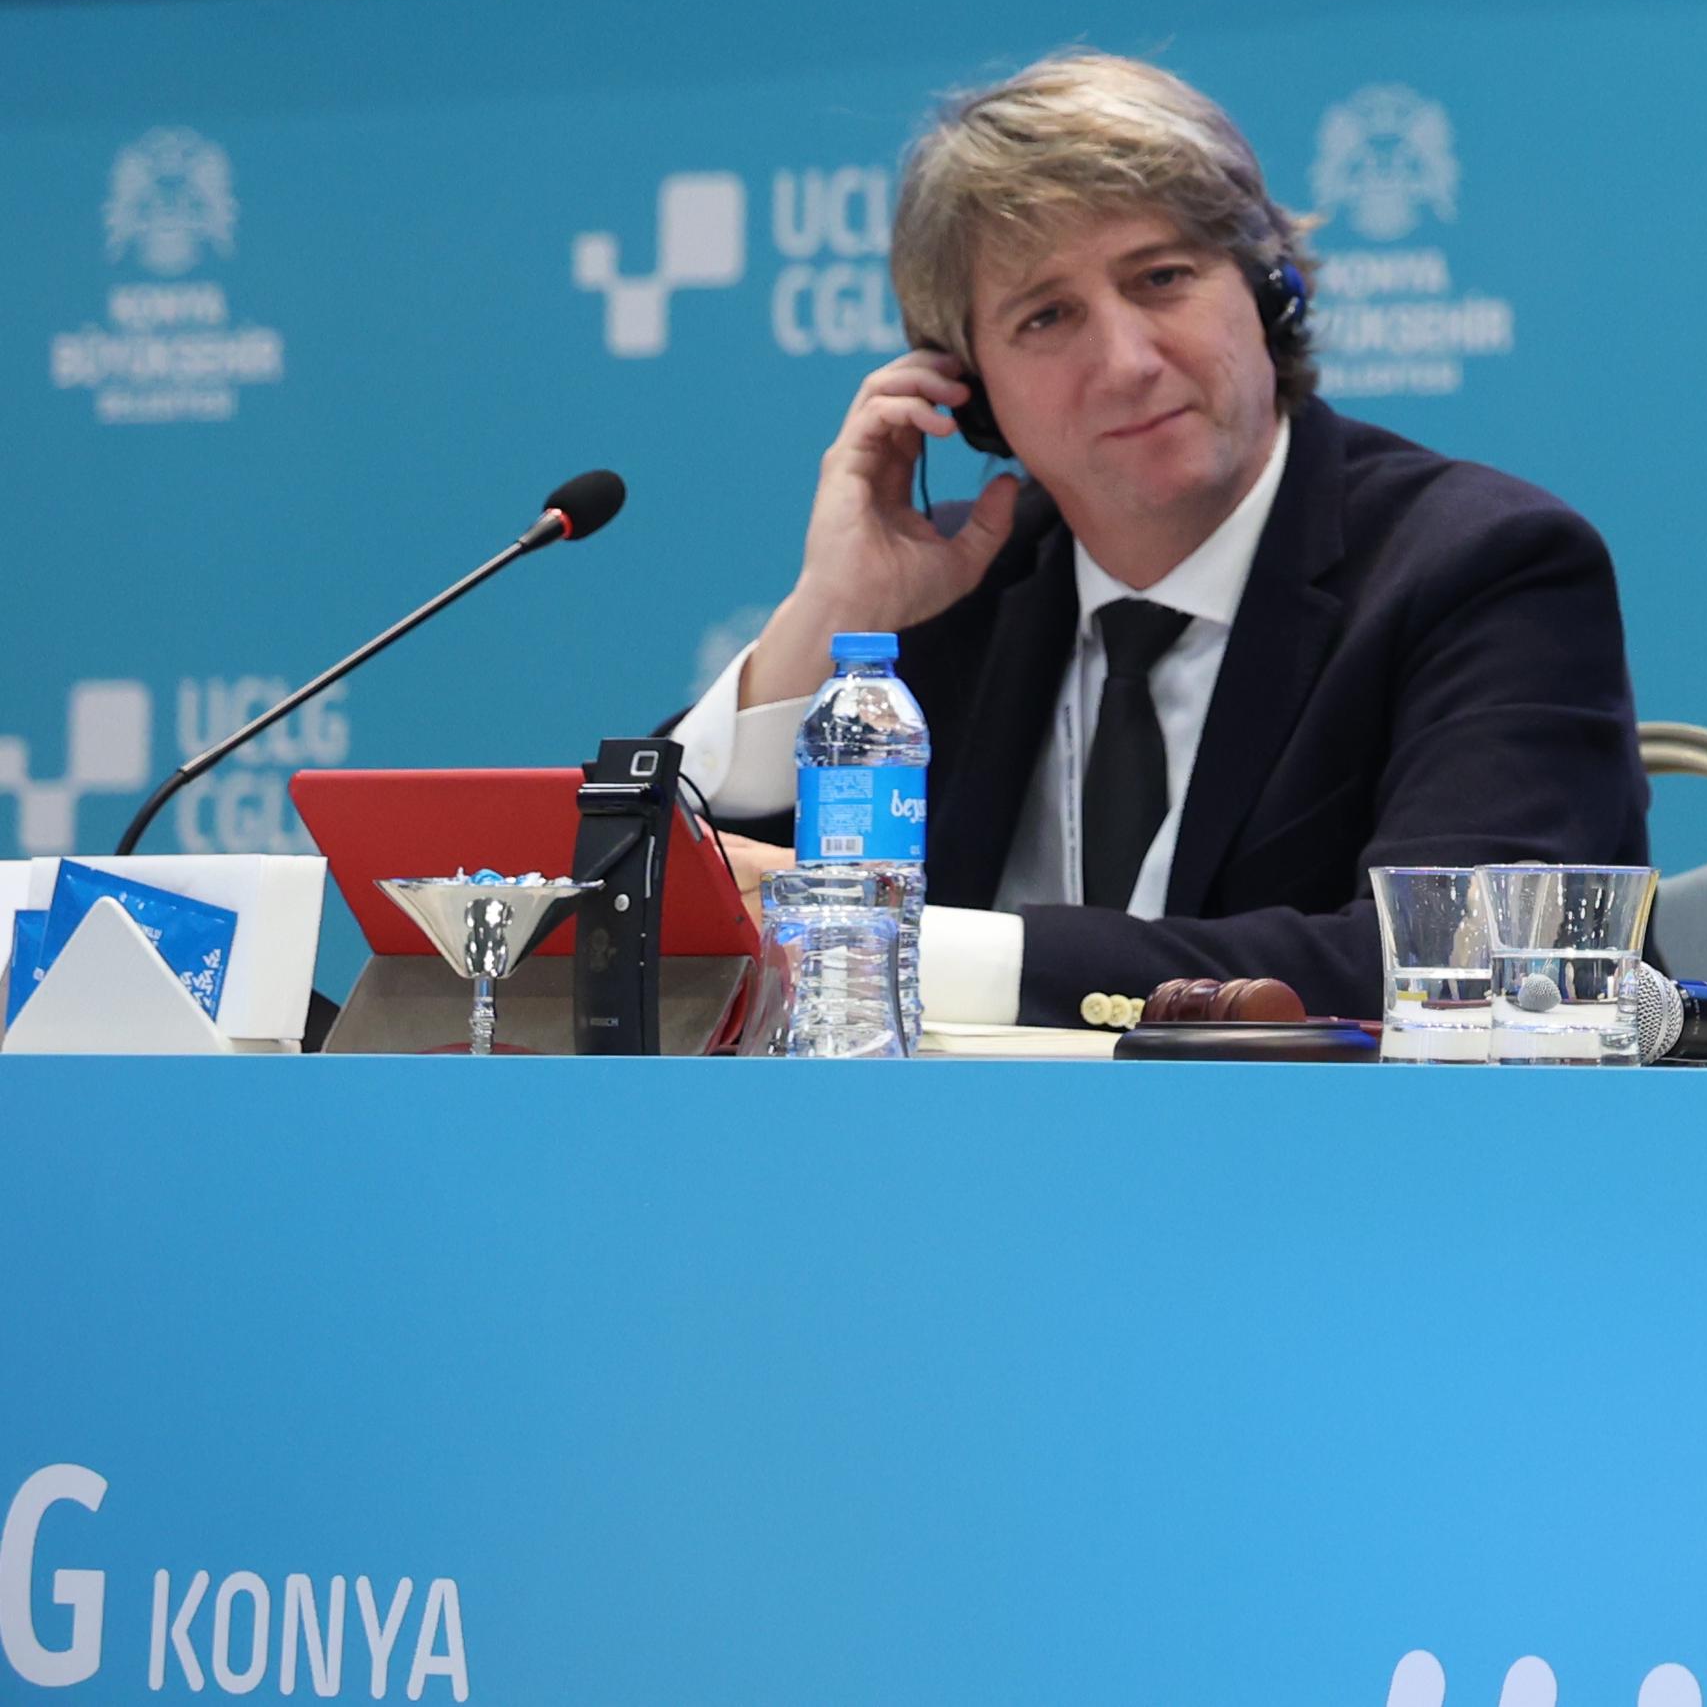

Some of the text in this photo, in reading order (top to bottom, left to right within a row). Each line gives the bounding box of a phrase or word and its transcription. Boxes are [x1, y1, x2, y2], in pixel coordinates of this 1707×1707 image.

[773, 167, 894, 259] UCL
[772, 263, 904, 355] CGL
[176, 771, 326, 855] CGL
[149, 1568, 469, 1703] KONYA
